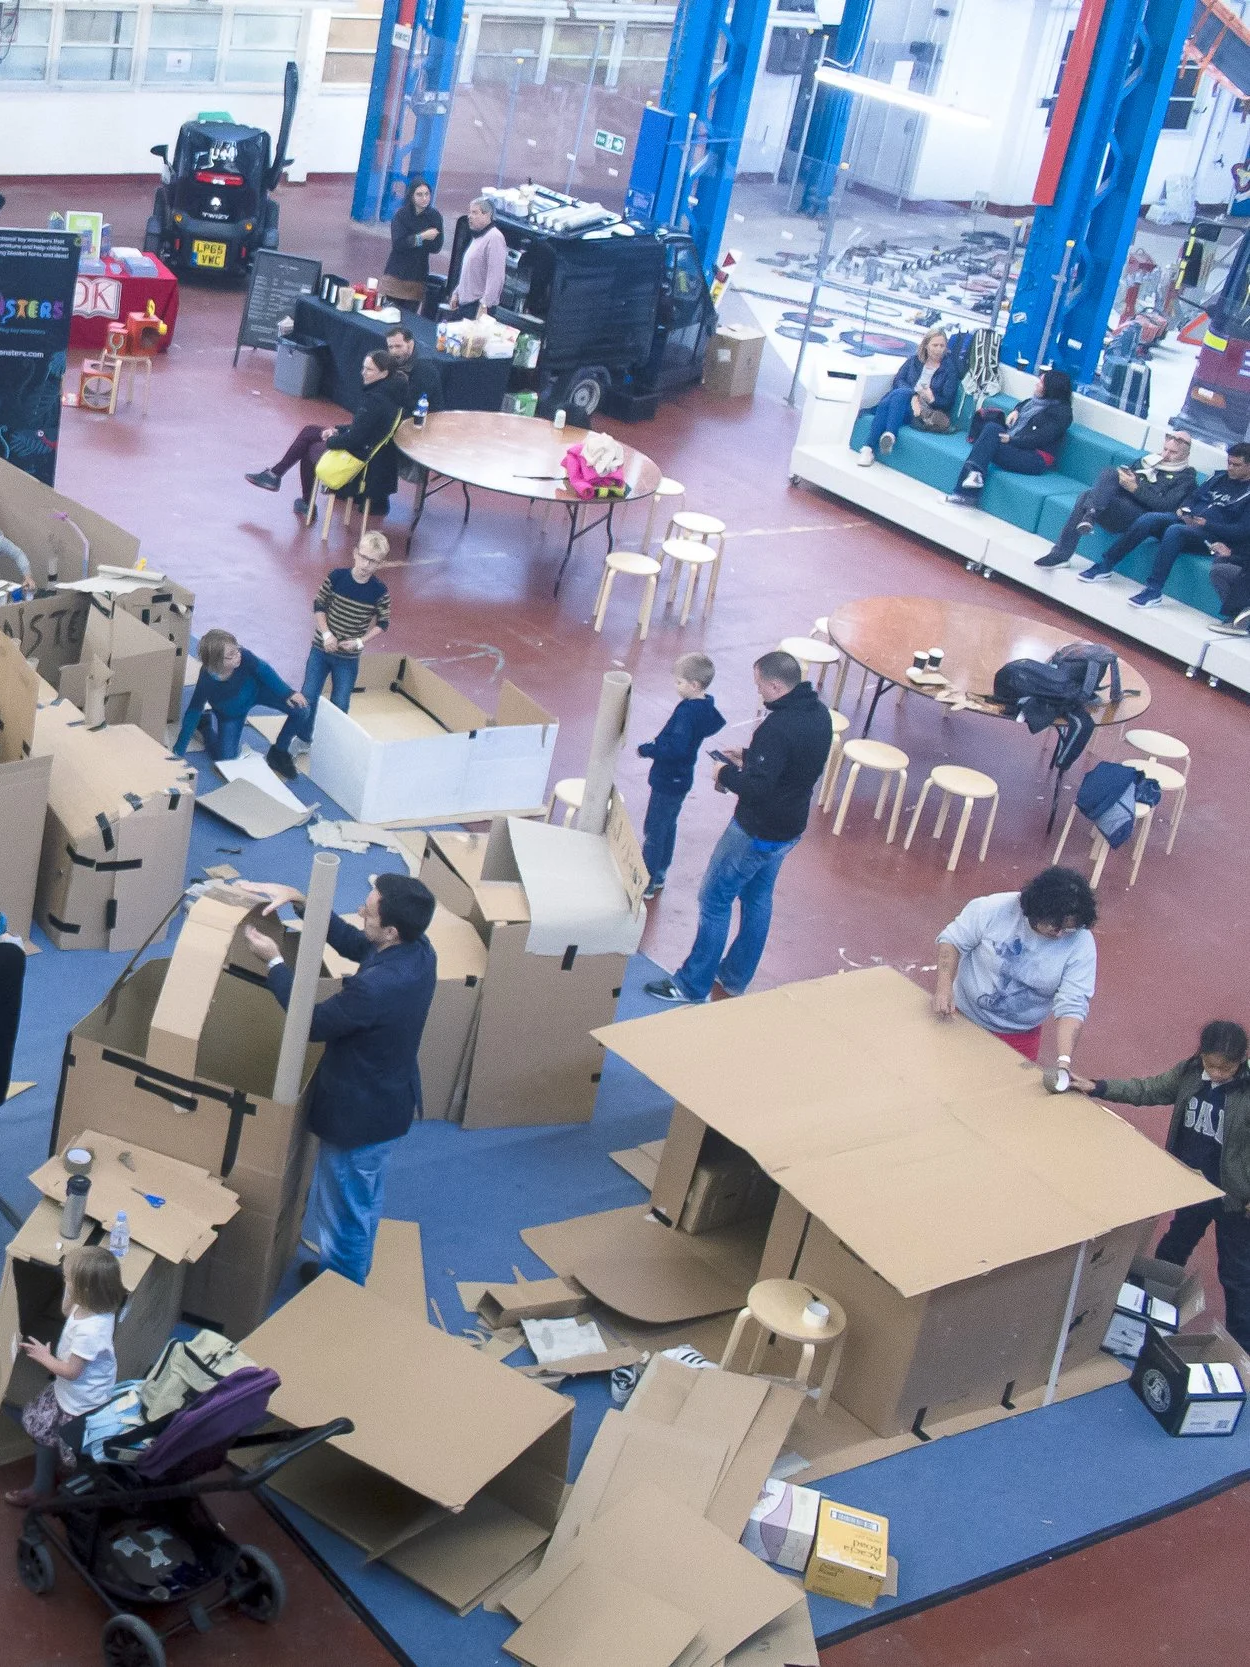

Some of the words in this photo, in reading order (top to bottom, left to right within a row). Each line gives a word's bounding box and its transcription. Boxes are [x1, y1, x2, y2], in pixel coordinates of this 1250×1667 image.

[198, 244, 224, 255] LP65
[202, 255, 221, 265] VWC
[843, 1545, 882, 1562] Acacia
[852, 1539, 882, 1555] Road
